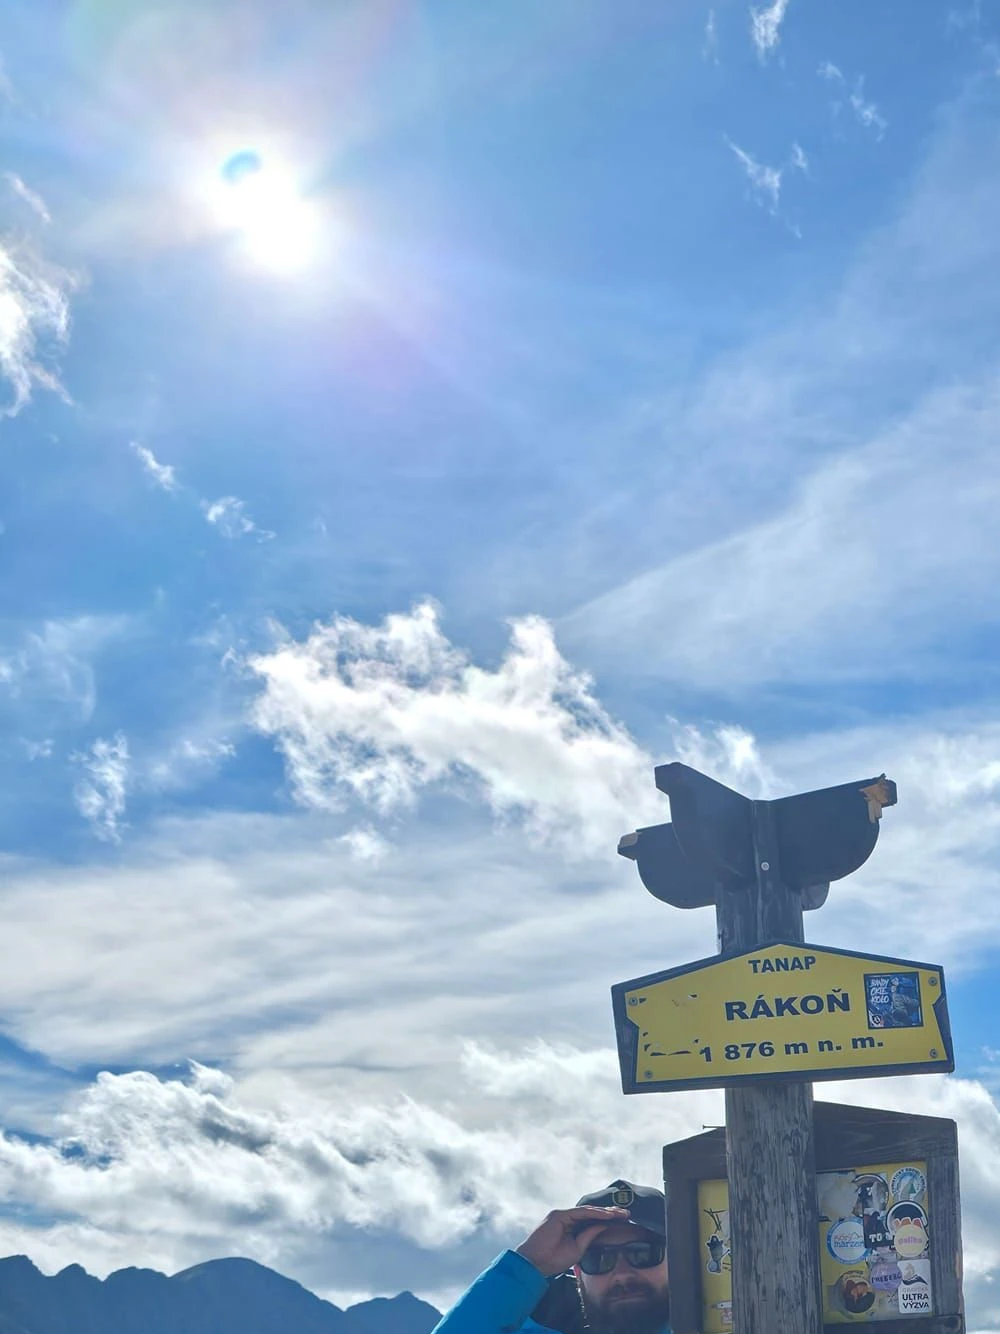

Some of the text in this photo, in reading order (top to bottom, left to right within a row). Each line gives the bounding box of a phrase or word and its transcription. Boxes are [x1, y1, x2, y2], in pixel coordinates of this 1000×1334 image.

[748, 955, 816, 975] TANAP
[724, 987, 851, 1022] RÁKOŇ
[700, 1034, 884, 1062] 1 876 m n. m.
[902, 1293, 929, 1301] ULTRA
[902, 1300, 930, 1309] VÝZVA
